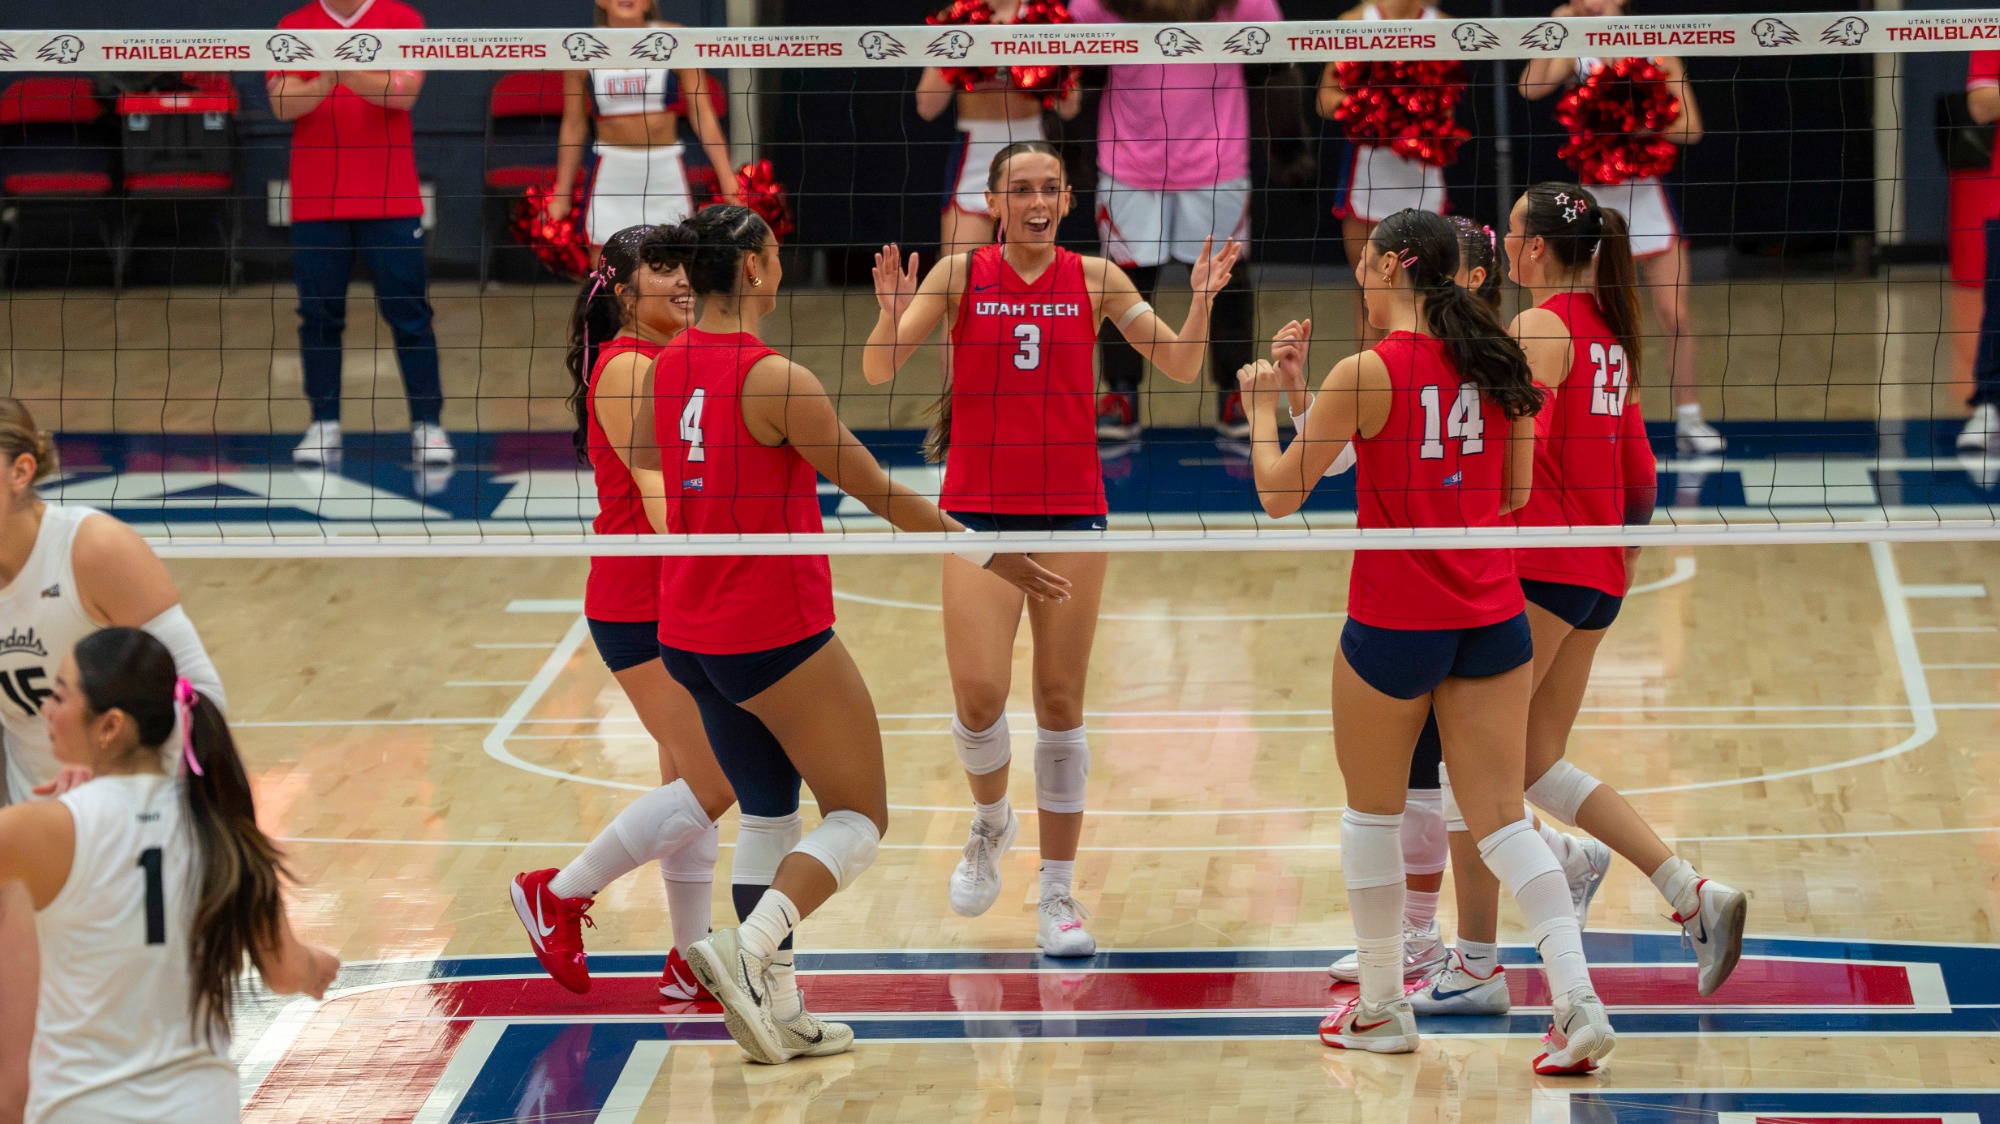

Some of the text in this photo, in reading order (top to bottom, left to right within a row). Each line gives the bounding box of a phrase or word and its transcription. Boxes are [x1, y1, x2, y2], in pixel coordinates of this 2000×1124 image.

[1585, 30, 1735, 46] TRAILBLAZERS
[1886, 25, 2000, 41] TRAILBLAZ
[694, 43, 843, 57] TRAILBLAZERS
[991, 40, 1139, 55] TRAILBLAZERS
[1287, 35, 1436, 51] TRAILBLAZERS
[101, 45, 251, 60] TRAILBLAZERS
[398, 44, 547, 59] TRAILBLAZERS
[975, 302, 1079, 317] UTAH TECH
[1012, 322, 1042, 371] 3
[1589, 341, 1630, 417] 23
[679, 386, 706, 463] 4
[1419, 380, 1485, 460] 14
[137, 846, 166, 946] 1
